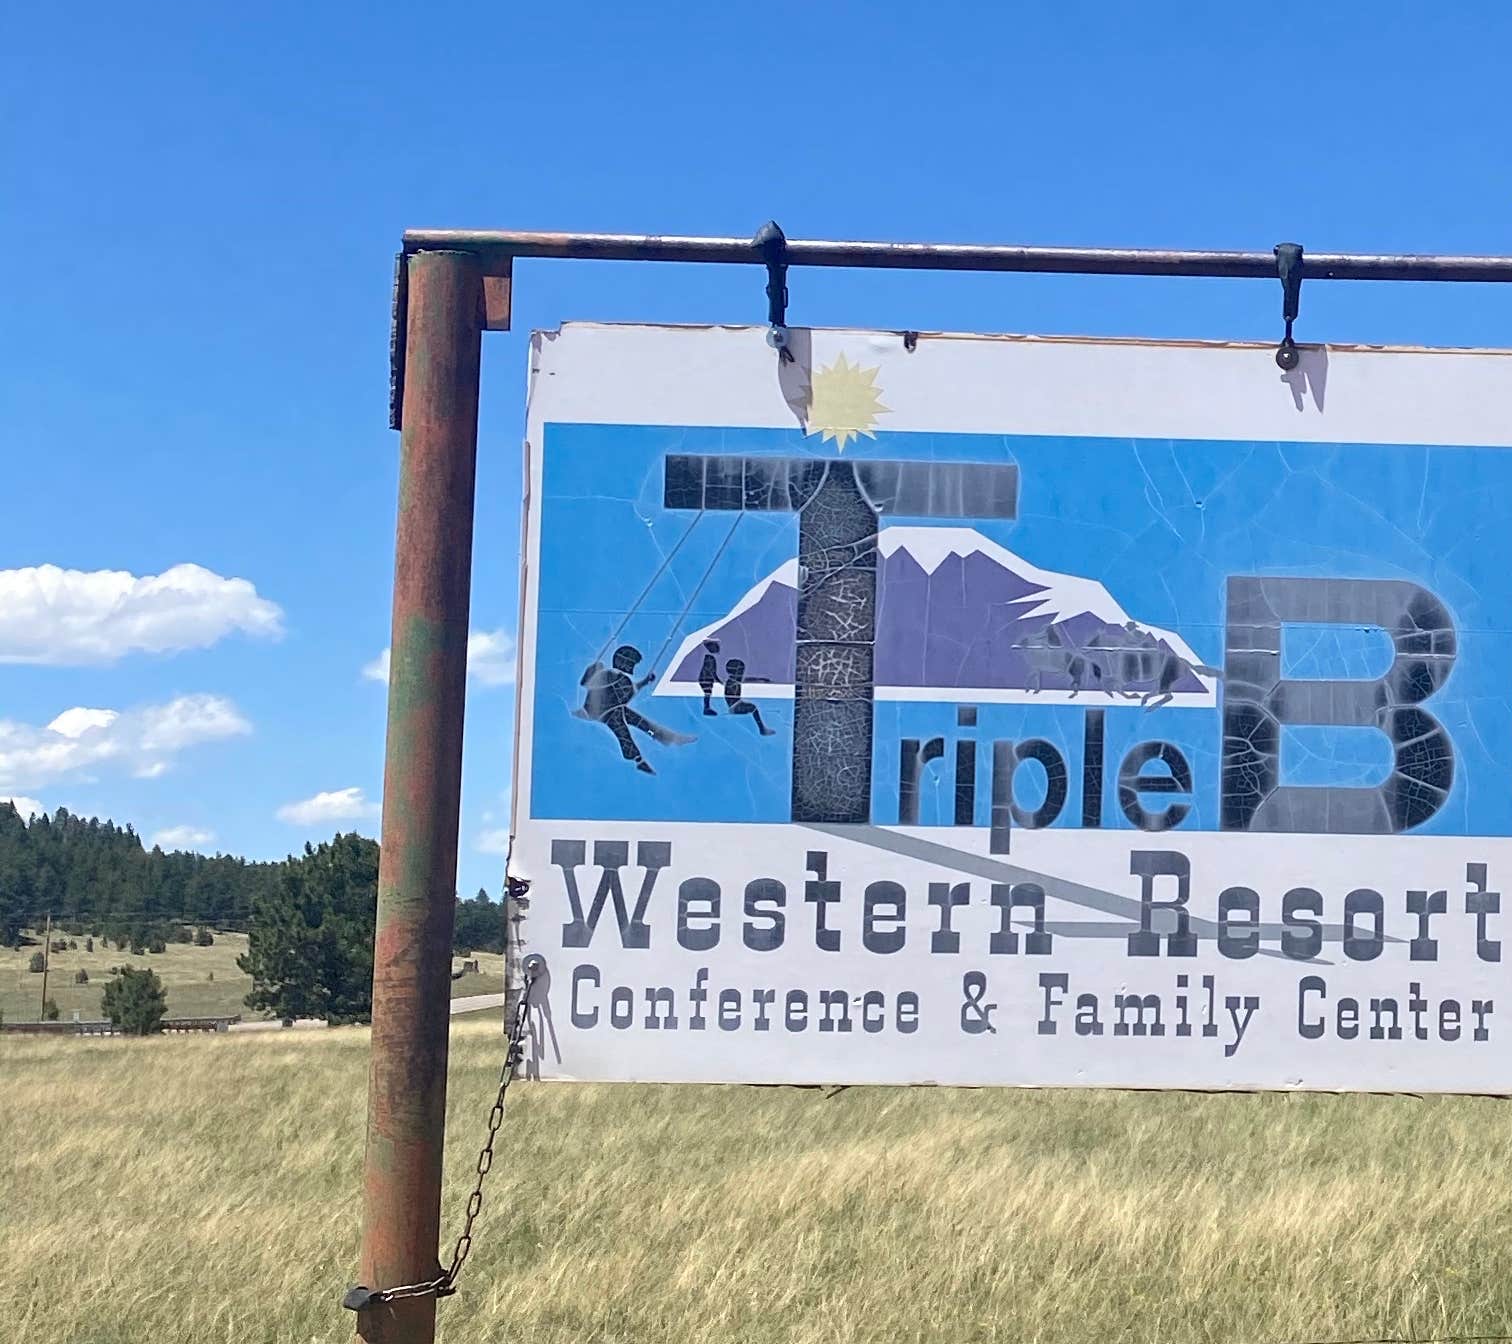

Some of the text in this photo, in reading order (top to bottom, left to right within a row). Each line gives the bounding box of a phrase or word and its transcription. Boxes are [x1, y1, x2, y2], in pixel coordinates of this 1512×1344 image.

[664, 454, 1457, 855] Triple B
[551, 839, 1502, 962] Western Resort
[570, 963, 1494, 1057] Conference & Family Center
